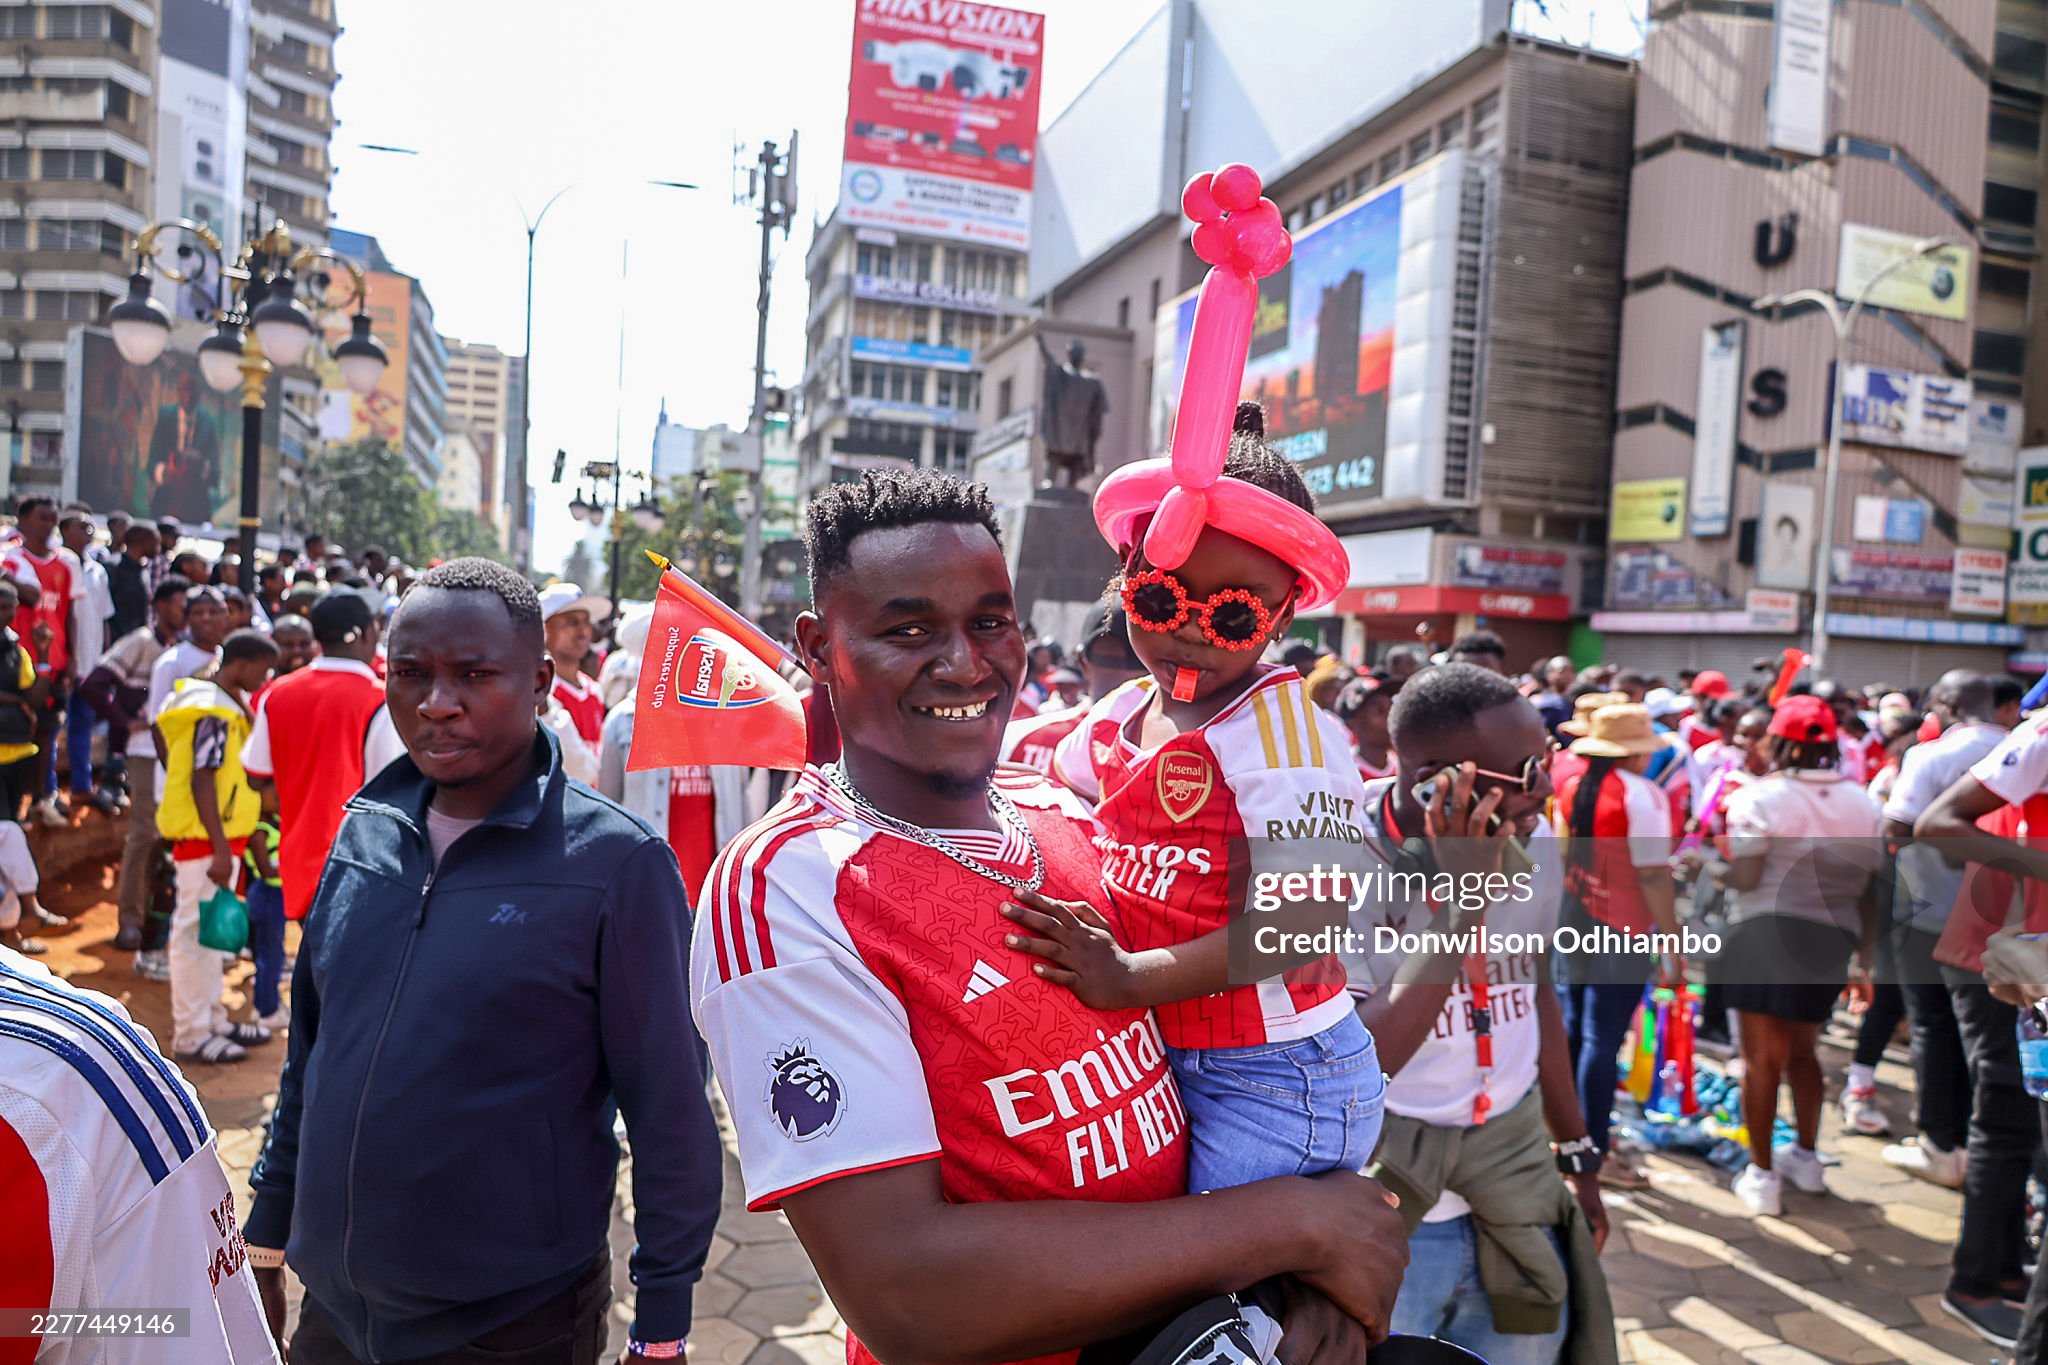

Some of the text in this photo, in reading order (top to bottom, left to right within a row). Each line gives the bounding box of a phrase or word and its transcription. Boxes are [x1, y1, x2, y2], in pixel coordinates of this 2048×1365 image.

[1747, 368, 1788, 417] S
[1166, 762, 1201, 777] Arsenal
[1295, 791, 1355, 821] VISIT
[1065, 1108, 1130, 1189] FLY
